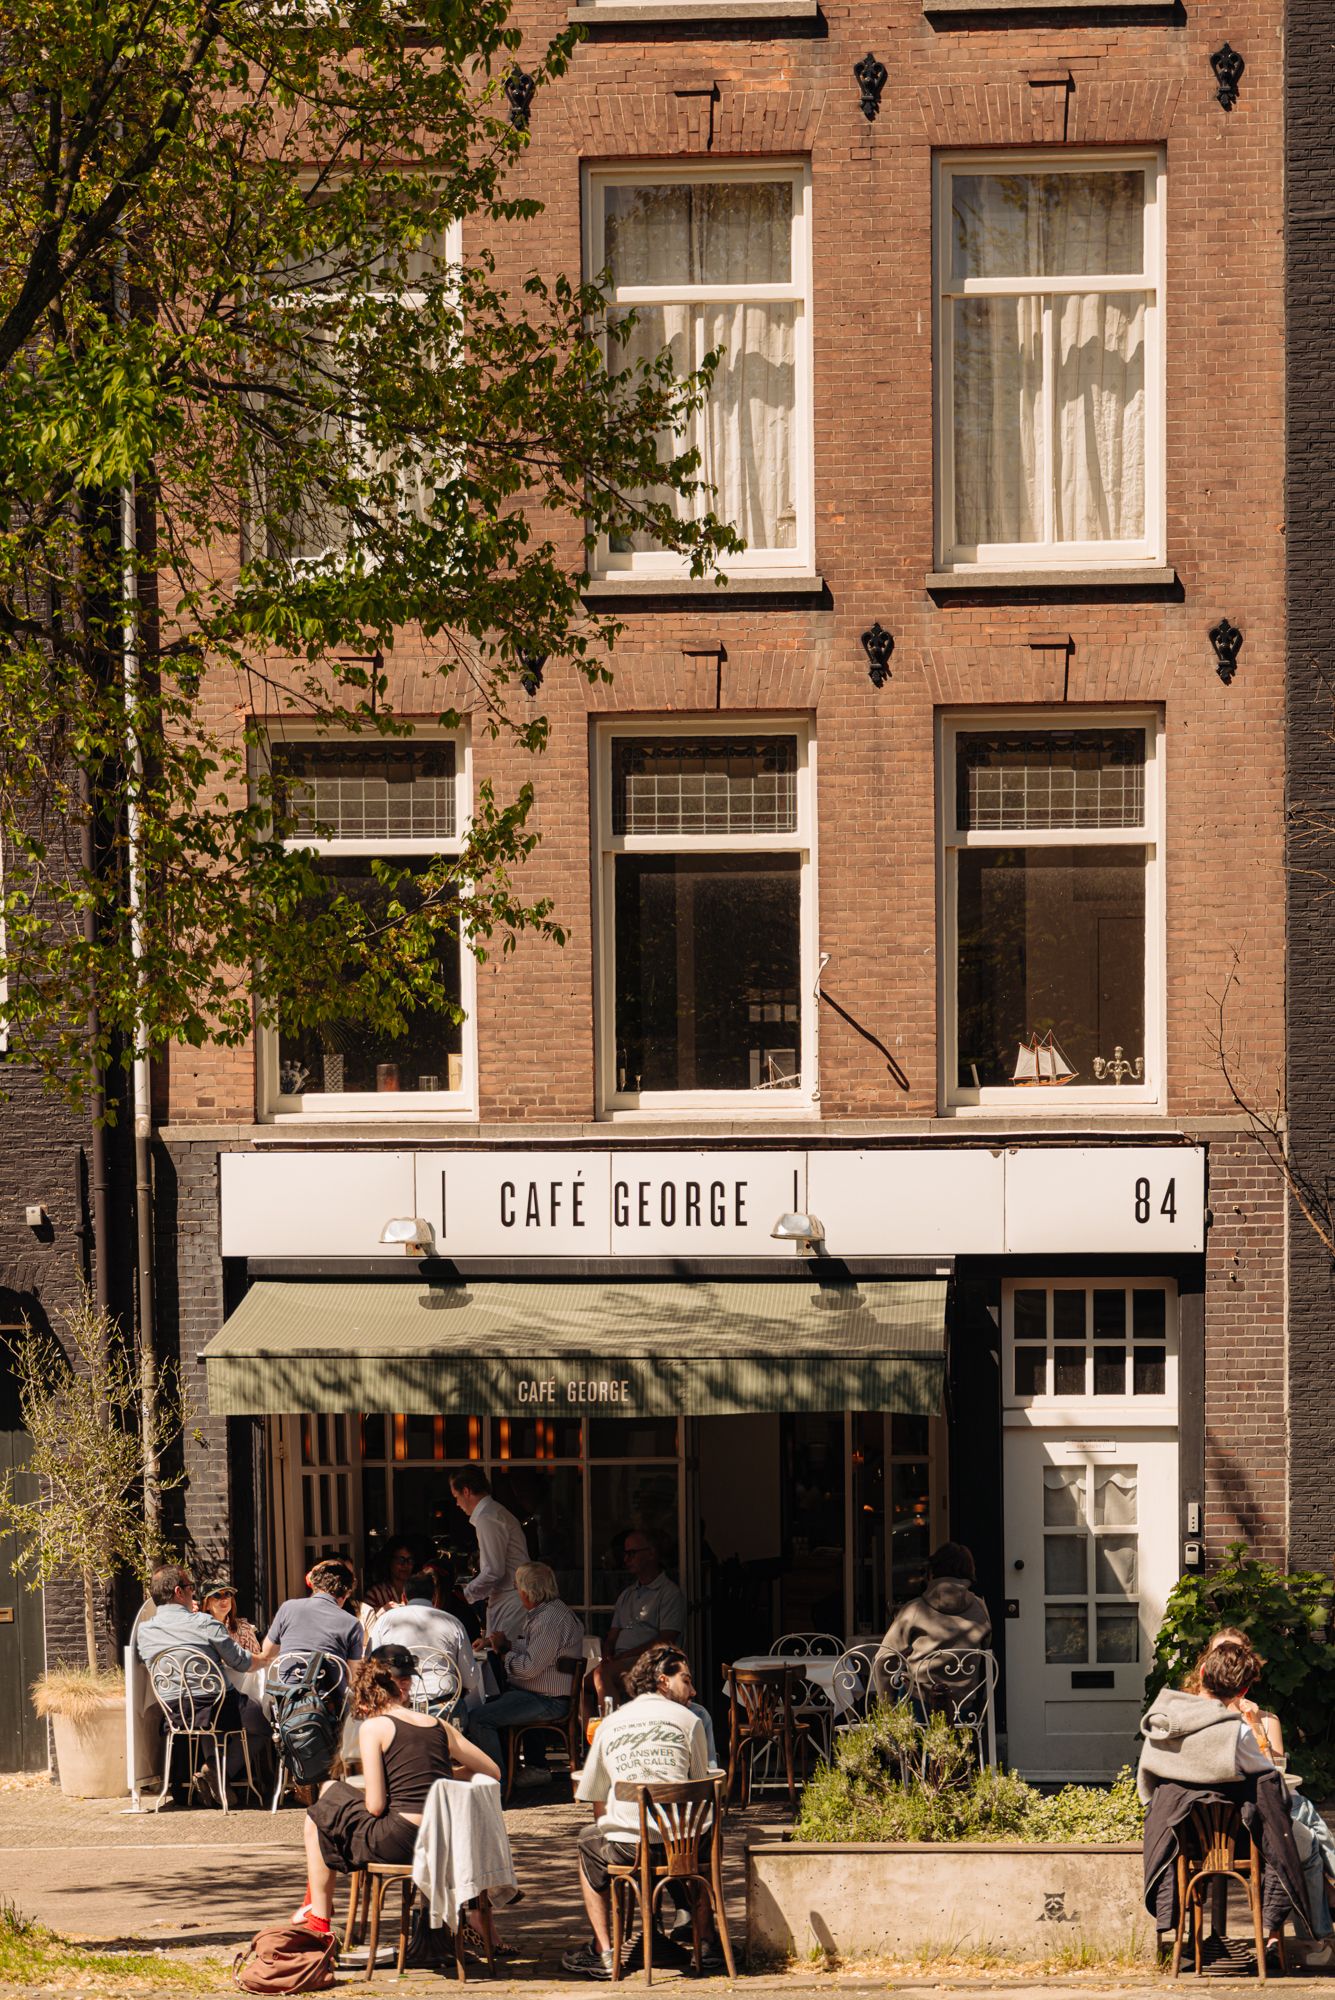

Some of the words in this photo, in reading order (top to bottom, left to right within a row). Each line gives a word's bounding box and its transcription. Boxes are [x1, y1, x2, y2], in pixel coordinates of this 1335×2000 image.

[500, 1170, 585, 1227] CAFÉ
[614, 1181, 748, 1227] GEORGE
[1135, 1177, 1177, 1224] 84
[518, 1376, 556, 1402] CAFÉ
[567, 1380, 629, 1402] GEORGE
[606, 1725, 685, 1756] carefree
[615, 1753, 627, 1763] TO
[629, 1748, 674, 1759] ANSWER
[616, 1759, 641, 1773] YOUR
[643, 1757, 677, 1767] CALLS
